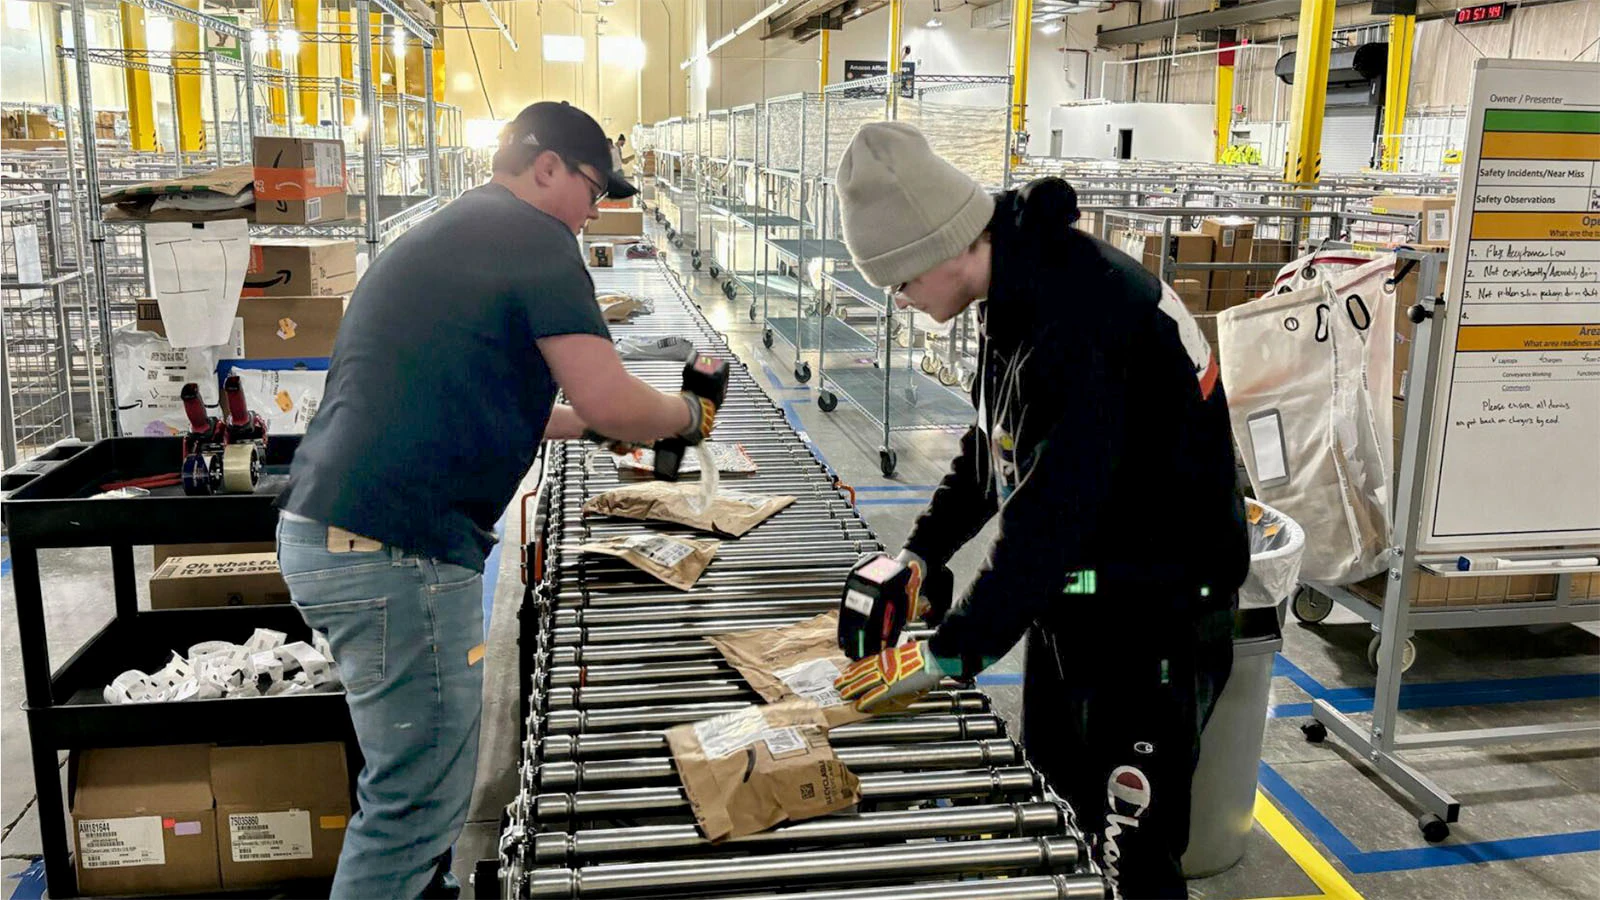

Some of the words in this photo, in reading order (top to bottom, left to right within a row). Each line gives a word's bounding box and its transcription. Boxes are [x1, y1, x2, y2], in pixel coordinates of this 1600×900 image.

[1489, 94, 1517, 103] Owner
[1525, 95, 1564, 104] Presenter
[1479, 168, 1505, 178] Safety
[1567, 170, 1585, 178] Miss
[1476, 195, 1502, 205] Safety
[1503, 195, 1556, 204] Observations
[1549, 229, 1568, 237] What
[1470, 249, 1477, 257] 1.
[1483, 265, 1499, 277] Not
[1464, 290, 1472, 298] 3.
[1478, 288, 1492, 299] Not
[1563, 339, 1592, 347] readiness
[1536, 399, 1547, 409] all
[213, 560, 256, 568] what
